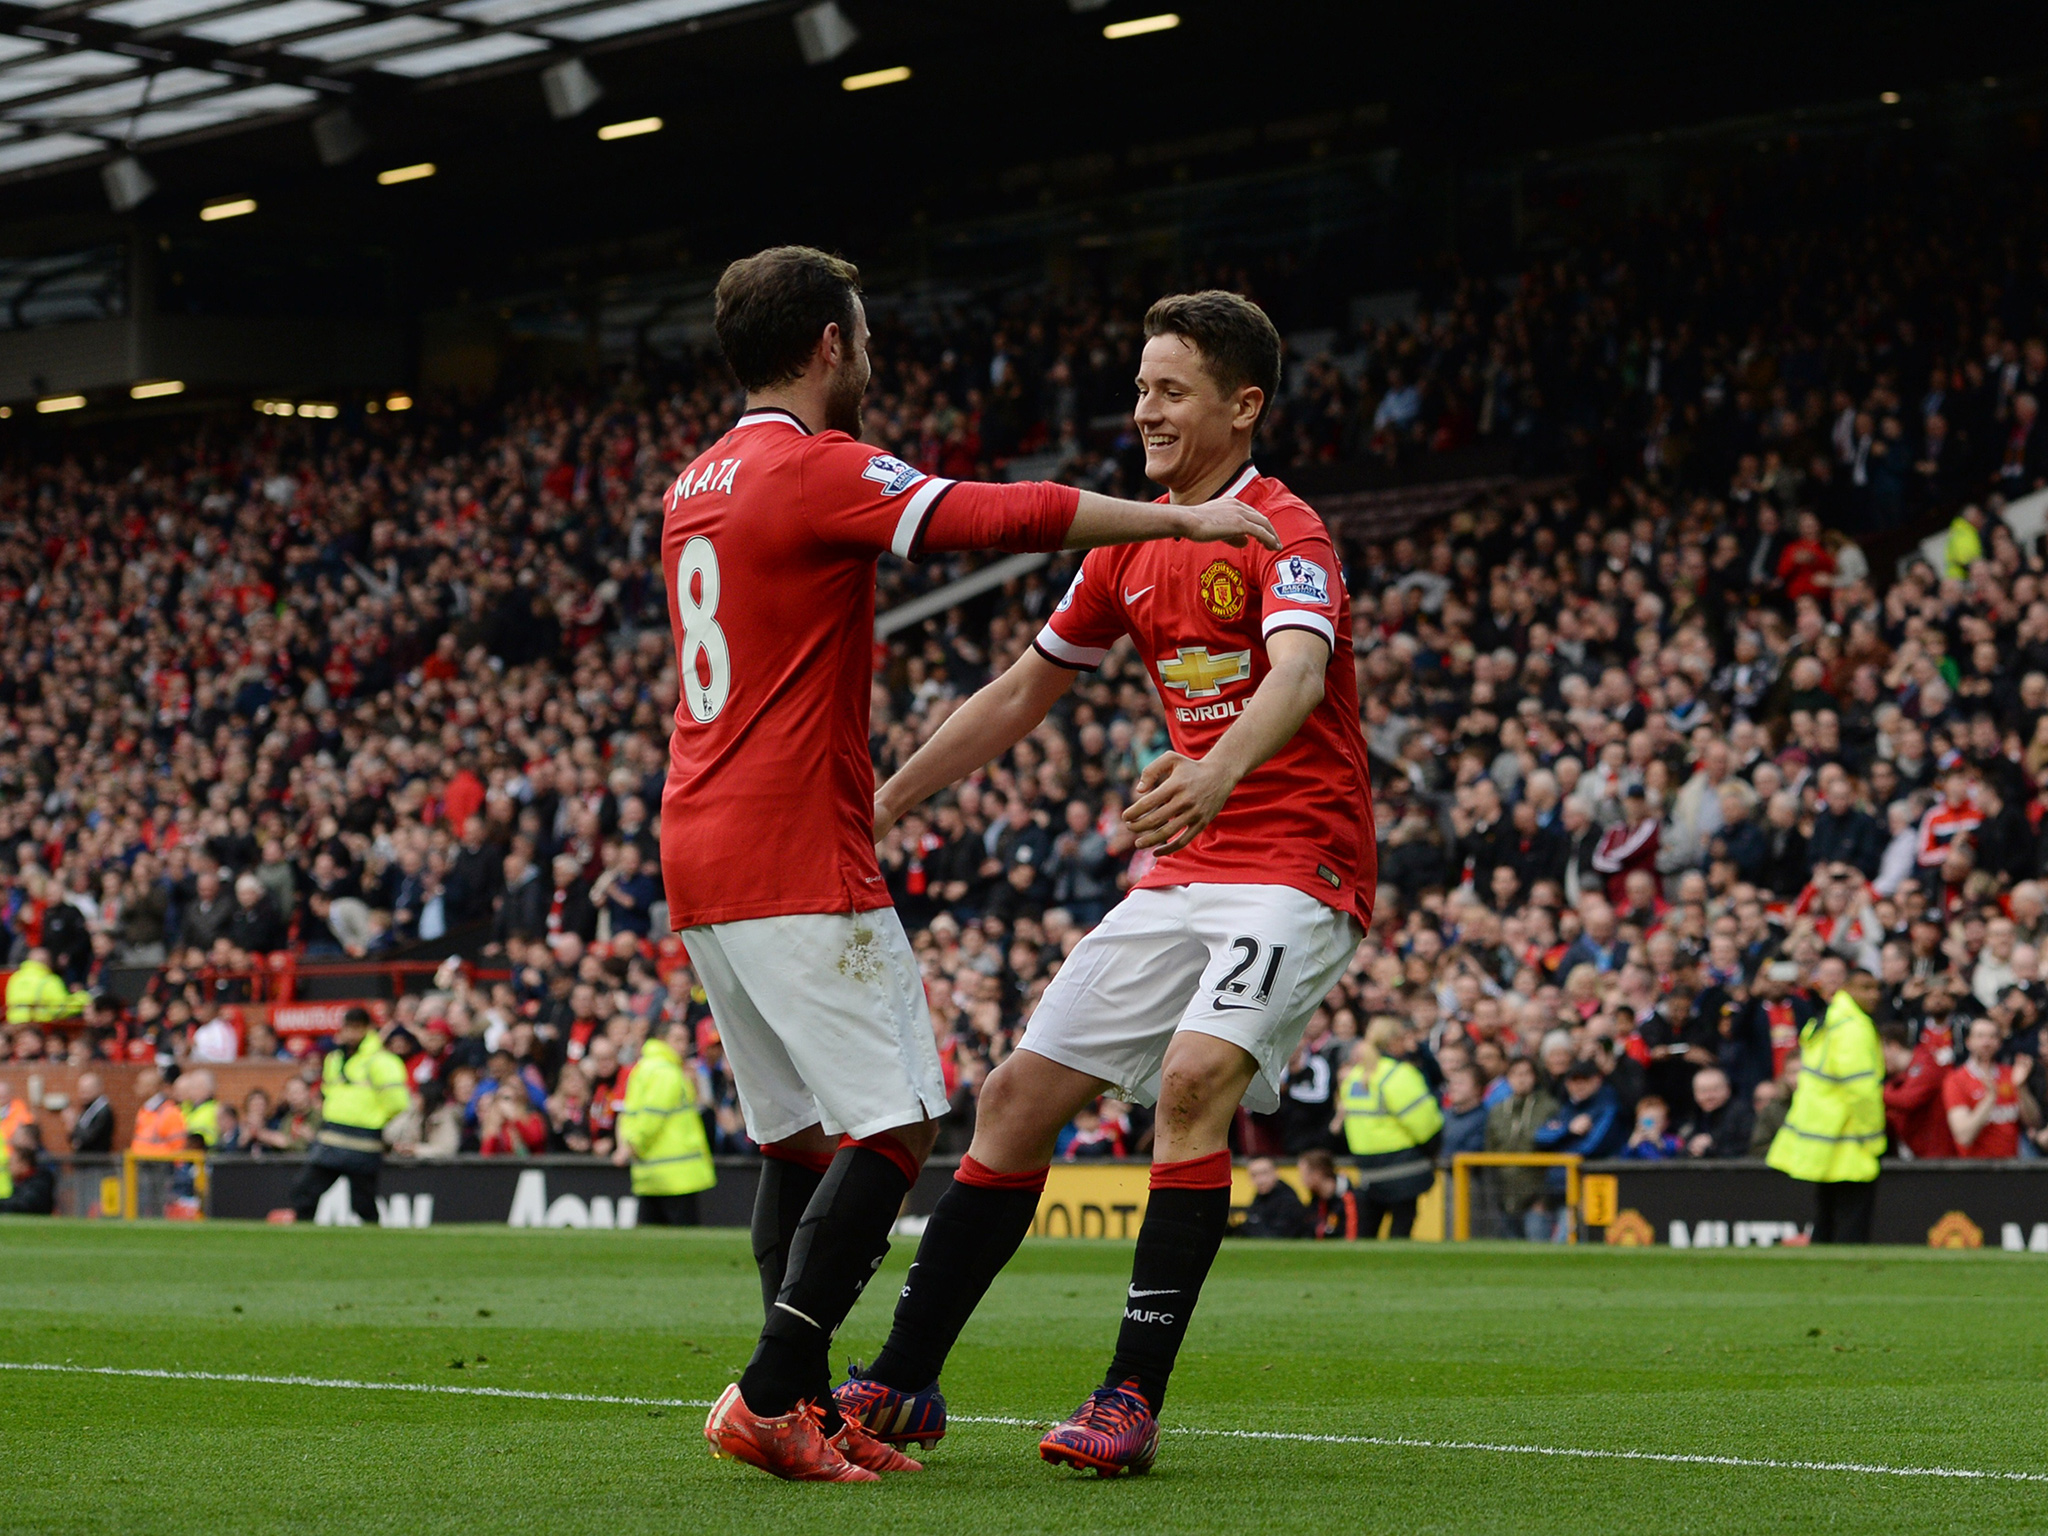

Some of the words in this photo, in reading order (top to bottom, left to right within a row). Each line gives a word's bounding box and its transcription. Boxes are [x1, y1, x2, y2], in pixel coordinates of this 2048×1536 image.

[671, 458, 742, 511] MATA
[1203, 563, 1240, 584] MANCHESTER
[1281, 584, 1317, 594] BARCLAYS
[1211, 604, 1239, 615] UNITED
[677, 535, 731, 724] 8
[1212, 935, 1287, 1006] 21
[1123, 1306, 1175, 1325] MUFC
